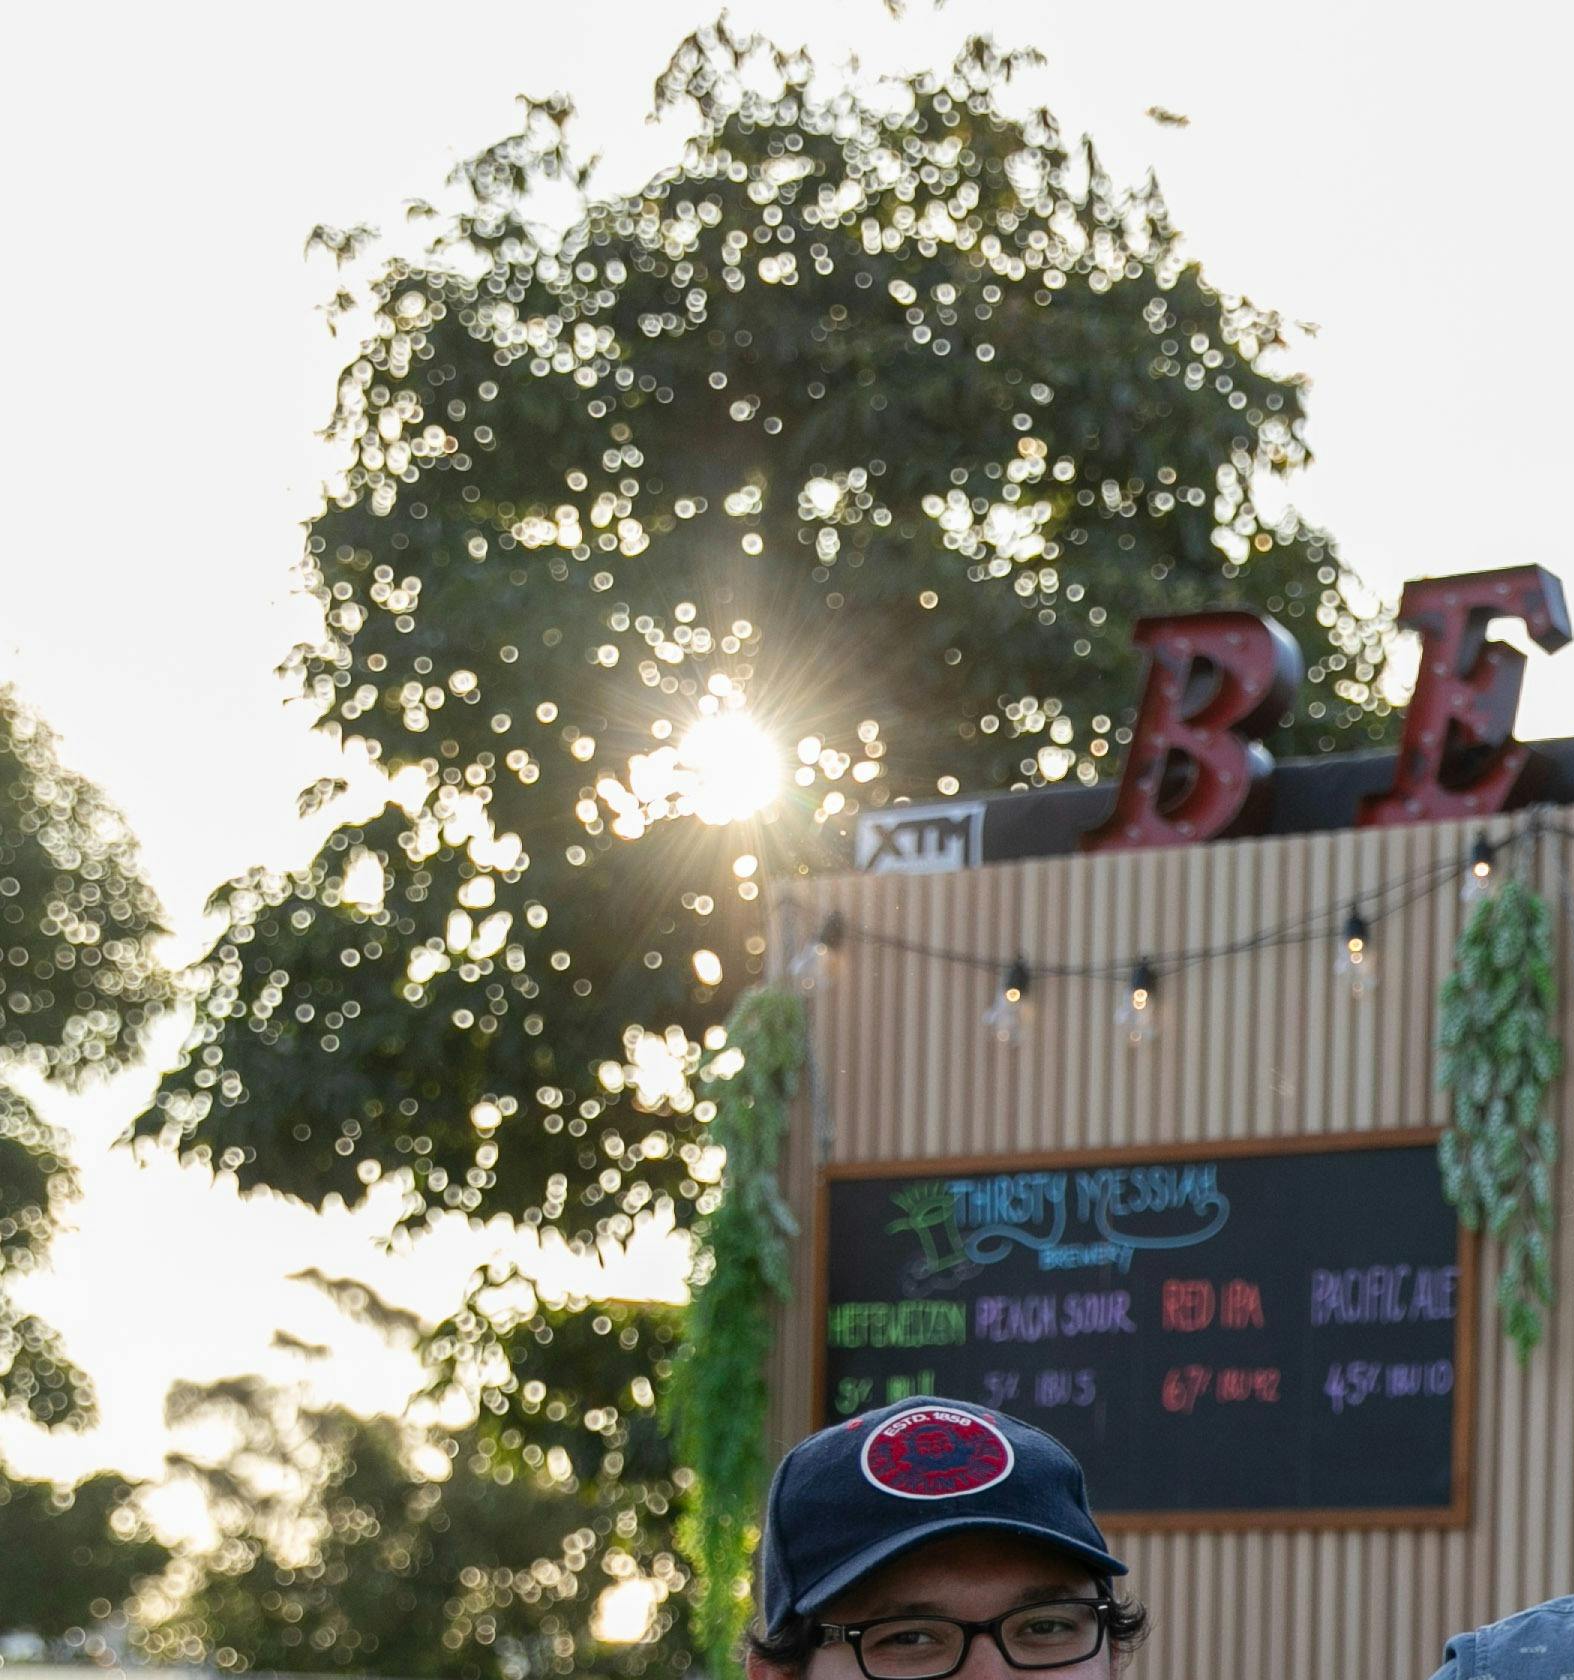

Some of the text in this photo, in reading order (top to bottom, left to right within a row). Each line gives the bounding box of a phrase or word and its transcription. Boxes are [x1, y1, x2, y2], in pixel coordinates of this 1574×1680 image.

[975, 1289, 1138, 1342] PEACH SOUR
[1161, 1277, 1265, 1333] RED IPA
[1310, 1265, 1462, 1328] PACIFIC ALE
[882, 1412, 931, 1437] ESTD.
